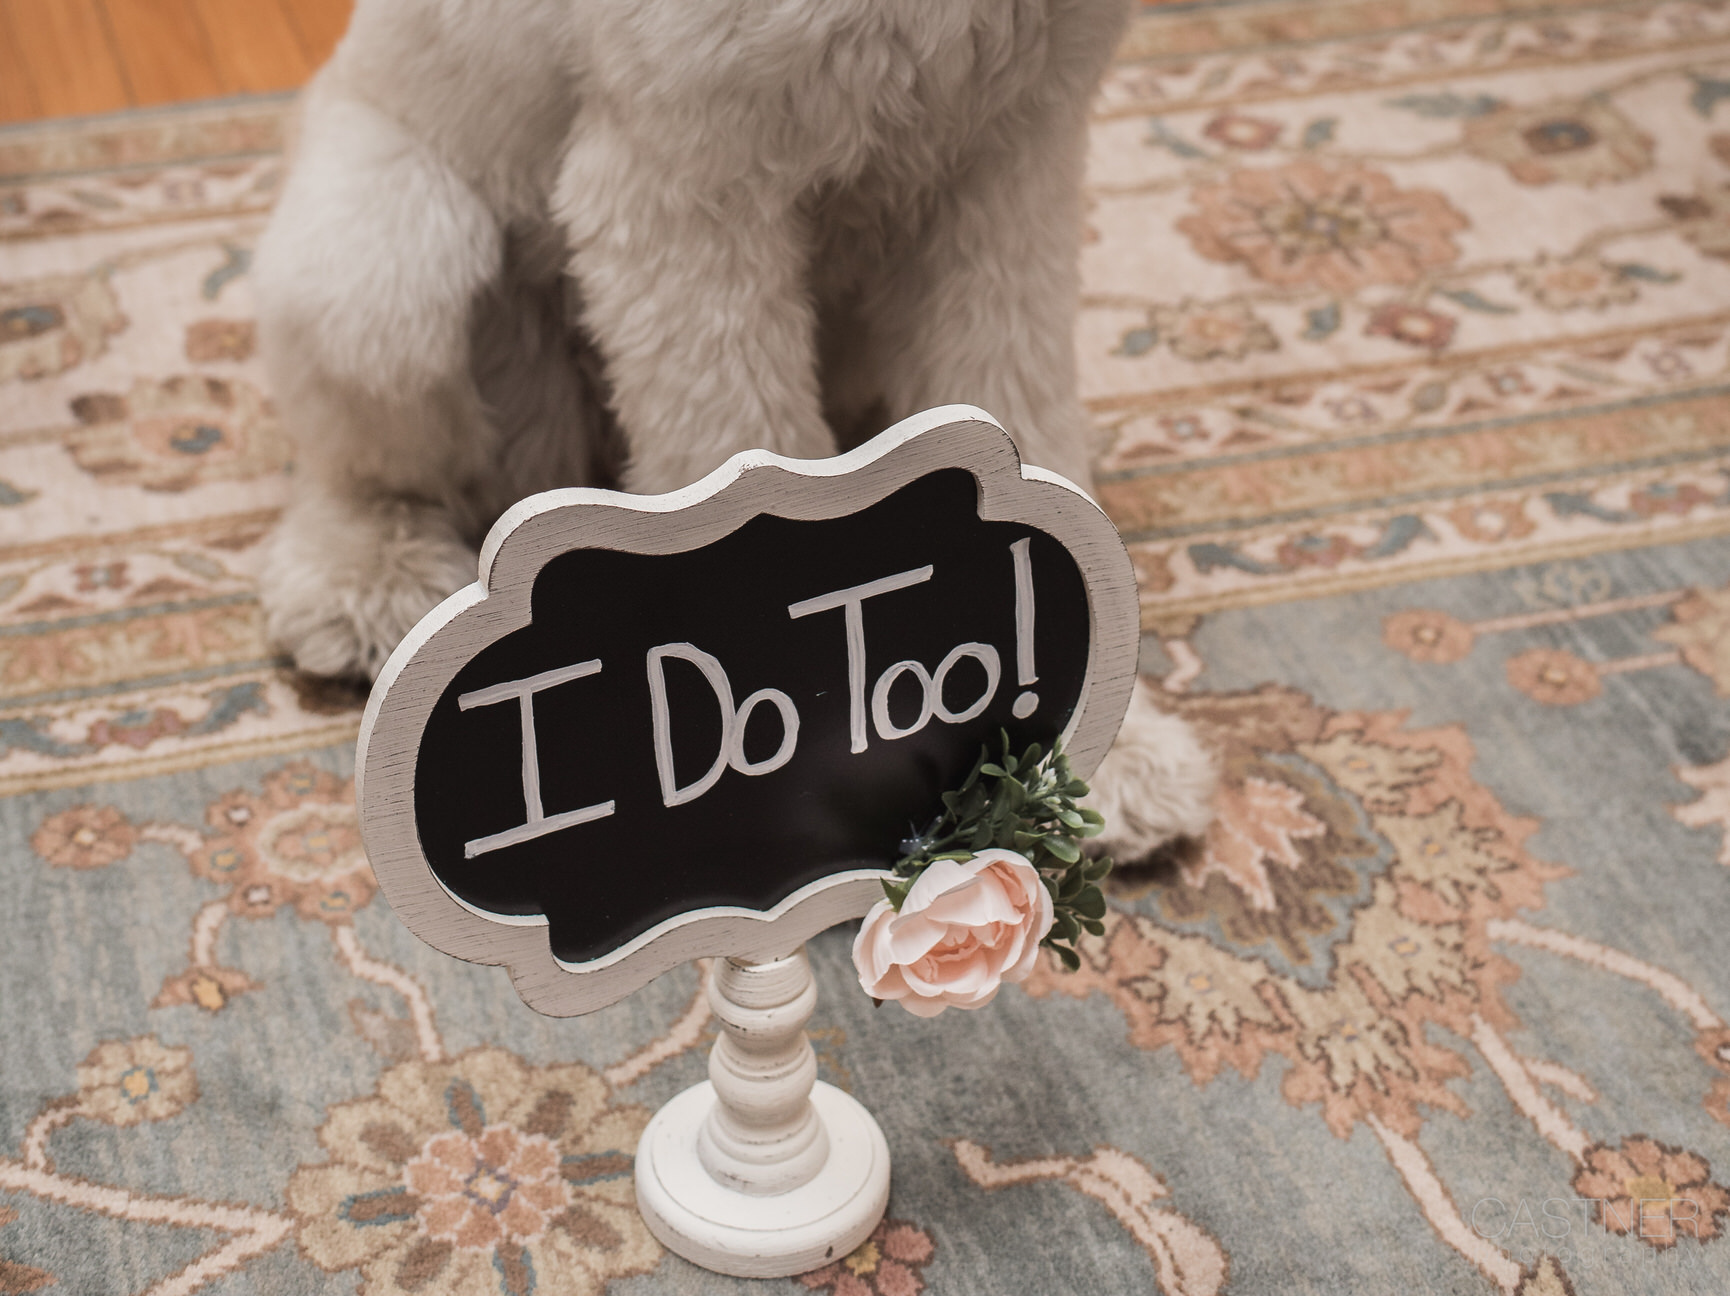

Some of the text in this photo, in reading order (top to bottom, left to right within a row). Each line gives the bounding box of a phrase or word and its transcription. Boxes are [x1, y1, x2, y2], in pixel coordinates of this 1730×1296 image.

[459, 537, 1039, 859] I Do Too!
